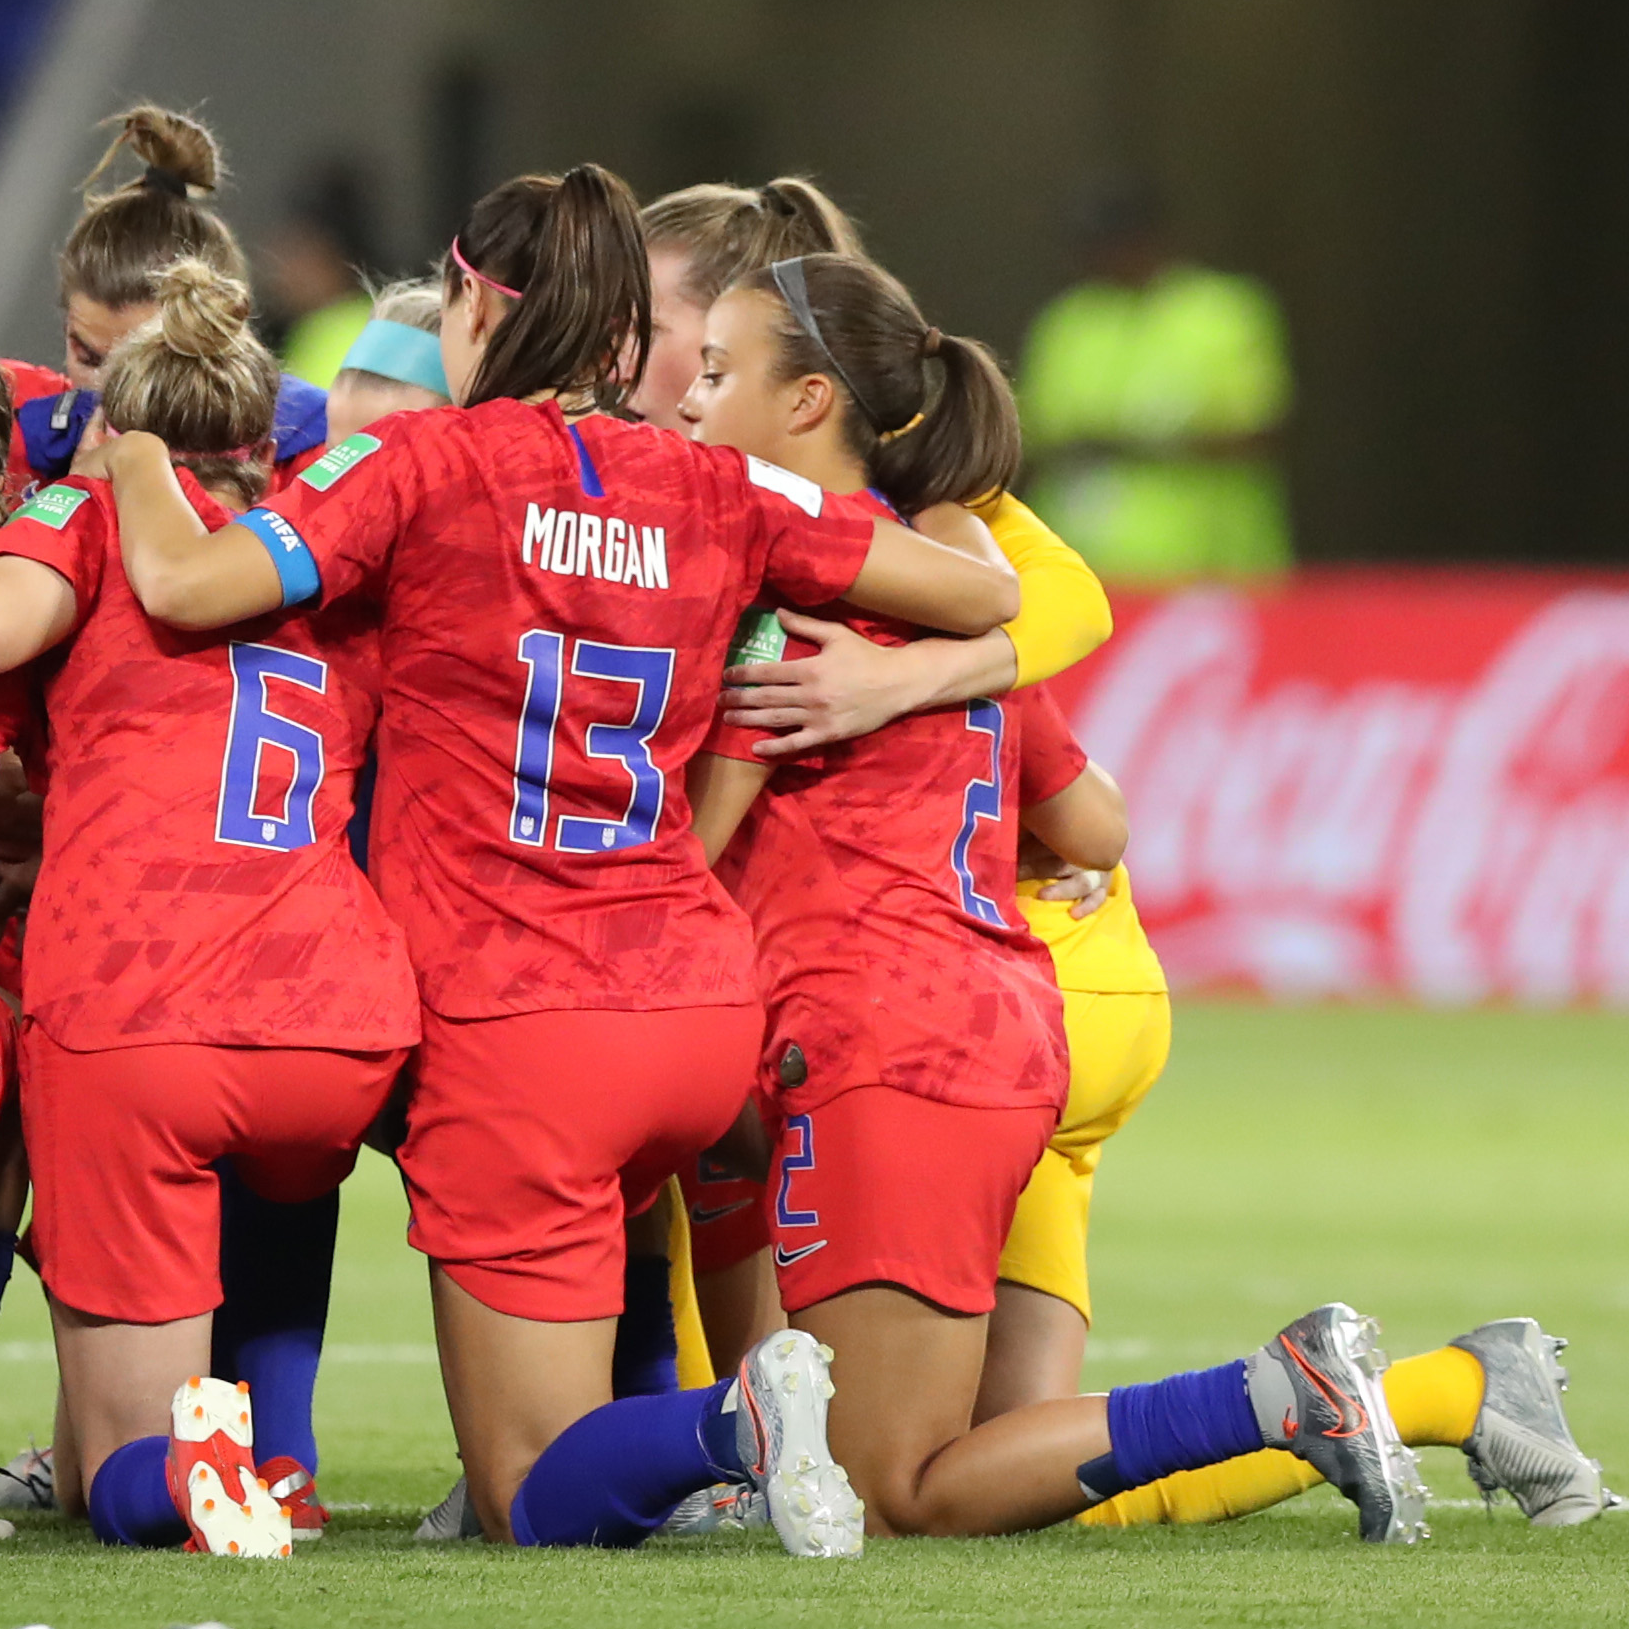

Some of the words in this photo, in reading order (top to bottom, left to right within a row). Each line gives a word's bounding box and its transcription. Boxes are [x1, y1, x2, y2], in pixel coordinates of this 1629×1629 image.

[261, 510, 302, 553] FIFA
[521, 501, 670, 590] MORGAN
[214, 641, 329, 851] 6
[508, 629, 676, 854] 13
[951, 697, 1011, 930] 2
[775, 1114, 819, 1228] 2
